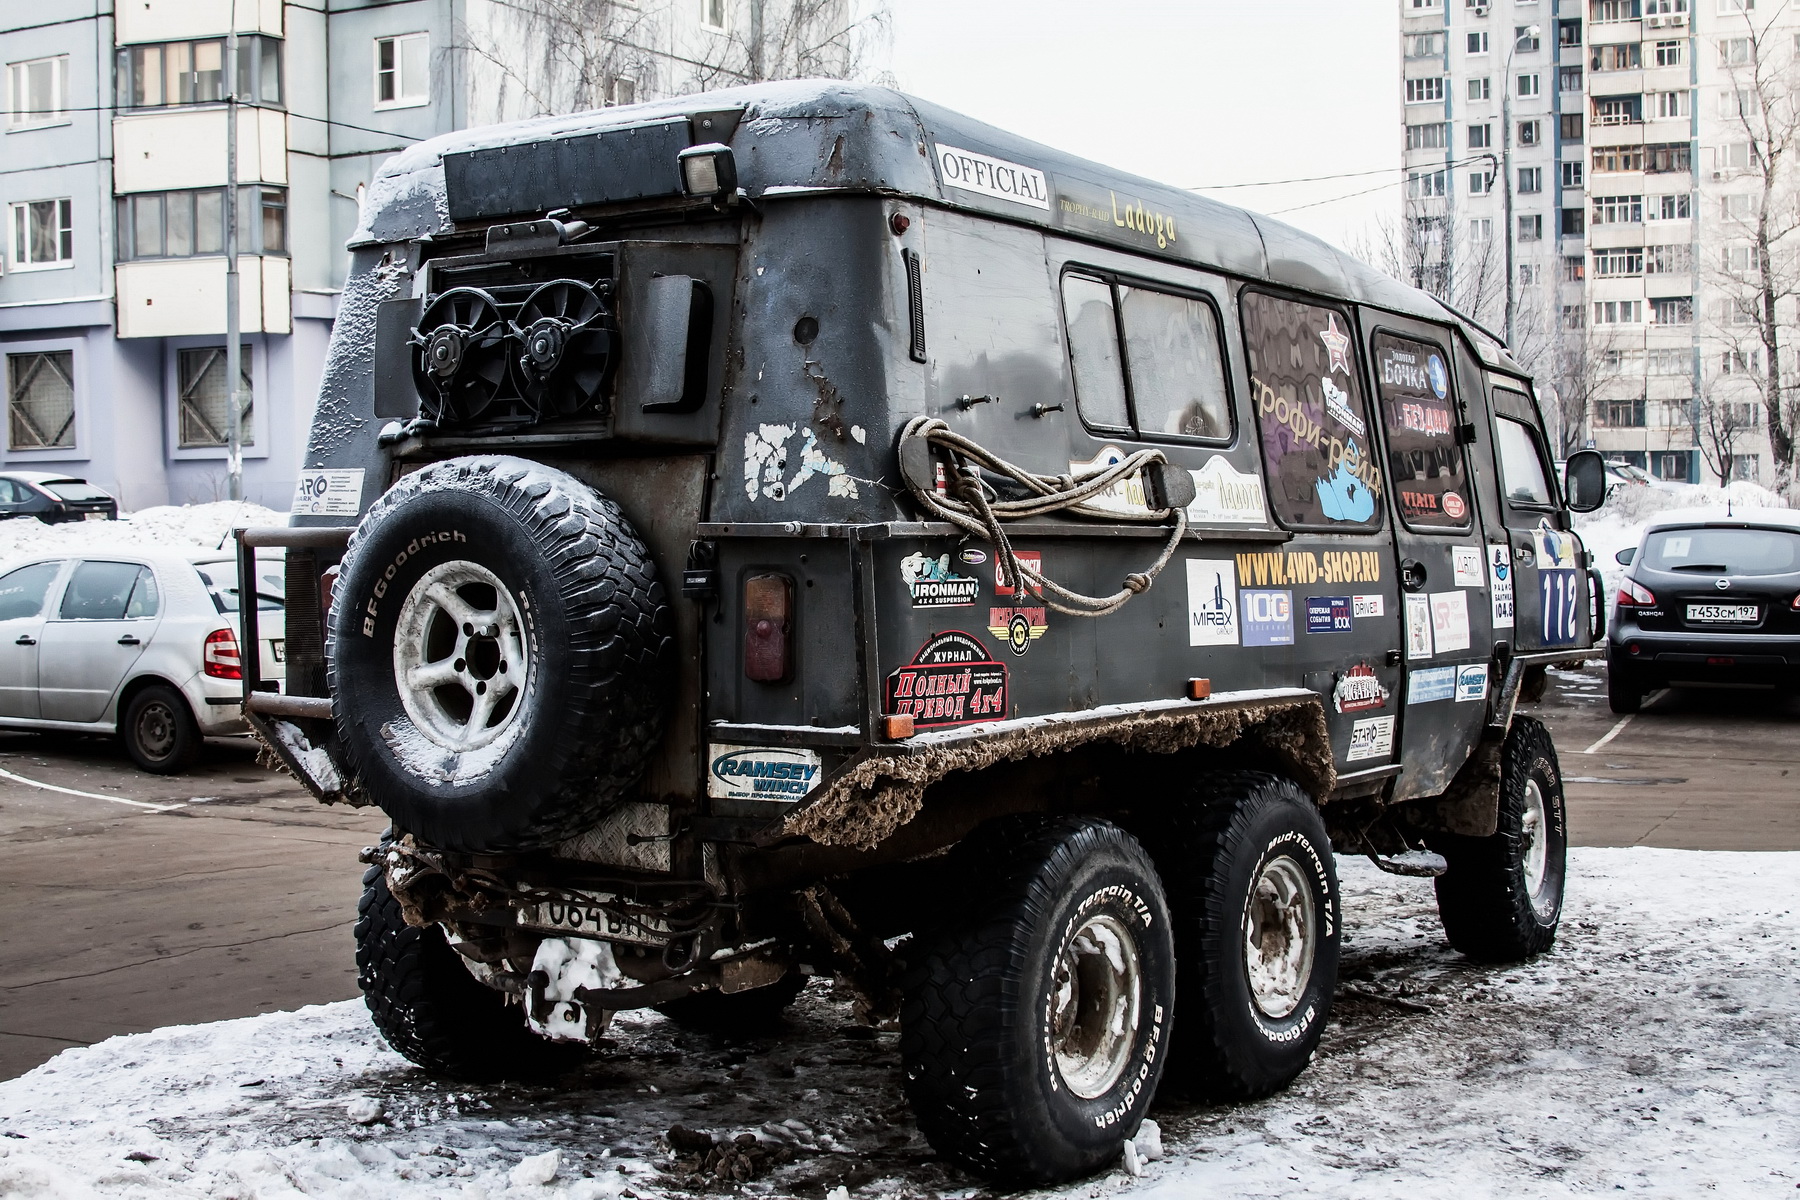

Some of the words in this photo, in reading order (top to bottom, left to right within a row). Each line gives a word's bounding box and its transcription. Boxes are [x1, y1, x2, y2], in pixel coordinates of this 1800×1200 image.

[943, 152, 1046, 202] OFFICIAL
[1060, 199, 1110, 222] TROPHY-RAID
[1110, 190, 1176, 249] Ladoga
[1391, 351, 1415, 363] ЗОЛОТАЯ
[1384, 358, 1427, 390] БОЧКА
[1402, 403, 1449, 437] БЕЗДНА
[1250, 375, 1381, 499] трофи-рейд
[1402, 491, 1437, 508] VIAIR
[363, 529, 467, 638] BFGoodrich
[1236, 551, 1379, 587] WWW.4WD-SHOP.RU
[915, 583, 975, 597] IRONMAN
[1335, 616, 1350, 628] BOOK
[1496, 602, 1513, 618] 104.8
[1544, 573, 1577, 641] 112
[1738, 607, 1754, 616] 197
[519, 590, 536, 697] Radial
[1216, 627, 1234, 635] GROUP
[919, 635, 953, 663] НАЦИОНАЛЬНЫЙ
[954, 635, 986, 660] ВНЕДОРОЖНЫЙ
[933, 650, 972, 663] ЖУРНАЛ
[1460, 674, 1486, 686] RAMSEY
[896, 696, 965, 720] ПРИВОД
[720, 760, 818, 781] RAMSEY
[754, 779, 809, 794] WINCH
[1552, 796, 1562, 837] STT
[1267, 830, 1329, 894] Mud-Terrain
[1324, 899, 1333, 937] T/A
[1133, 895, 1153, 928] T/A
[1248, 1002, 1316, 1042] BFGoodrich
[1095, 1004, 1164, 1130] BFGoodrich
